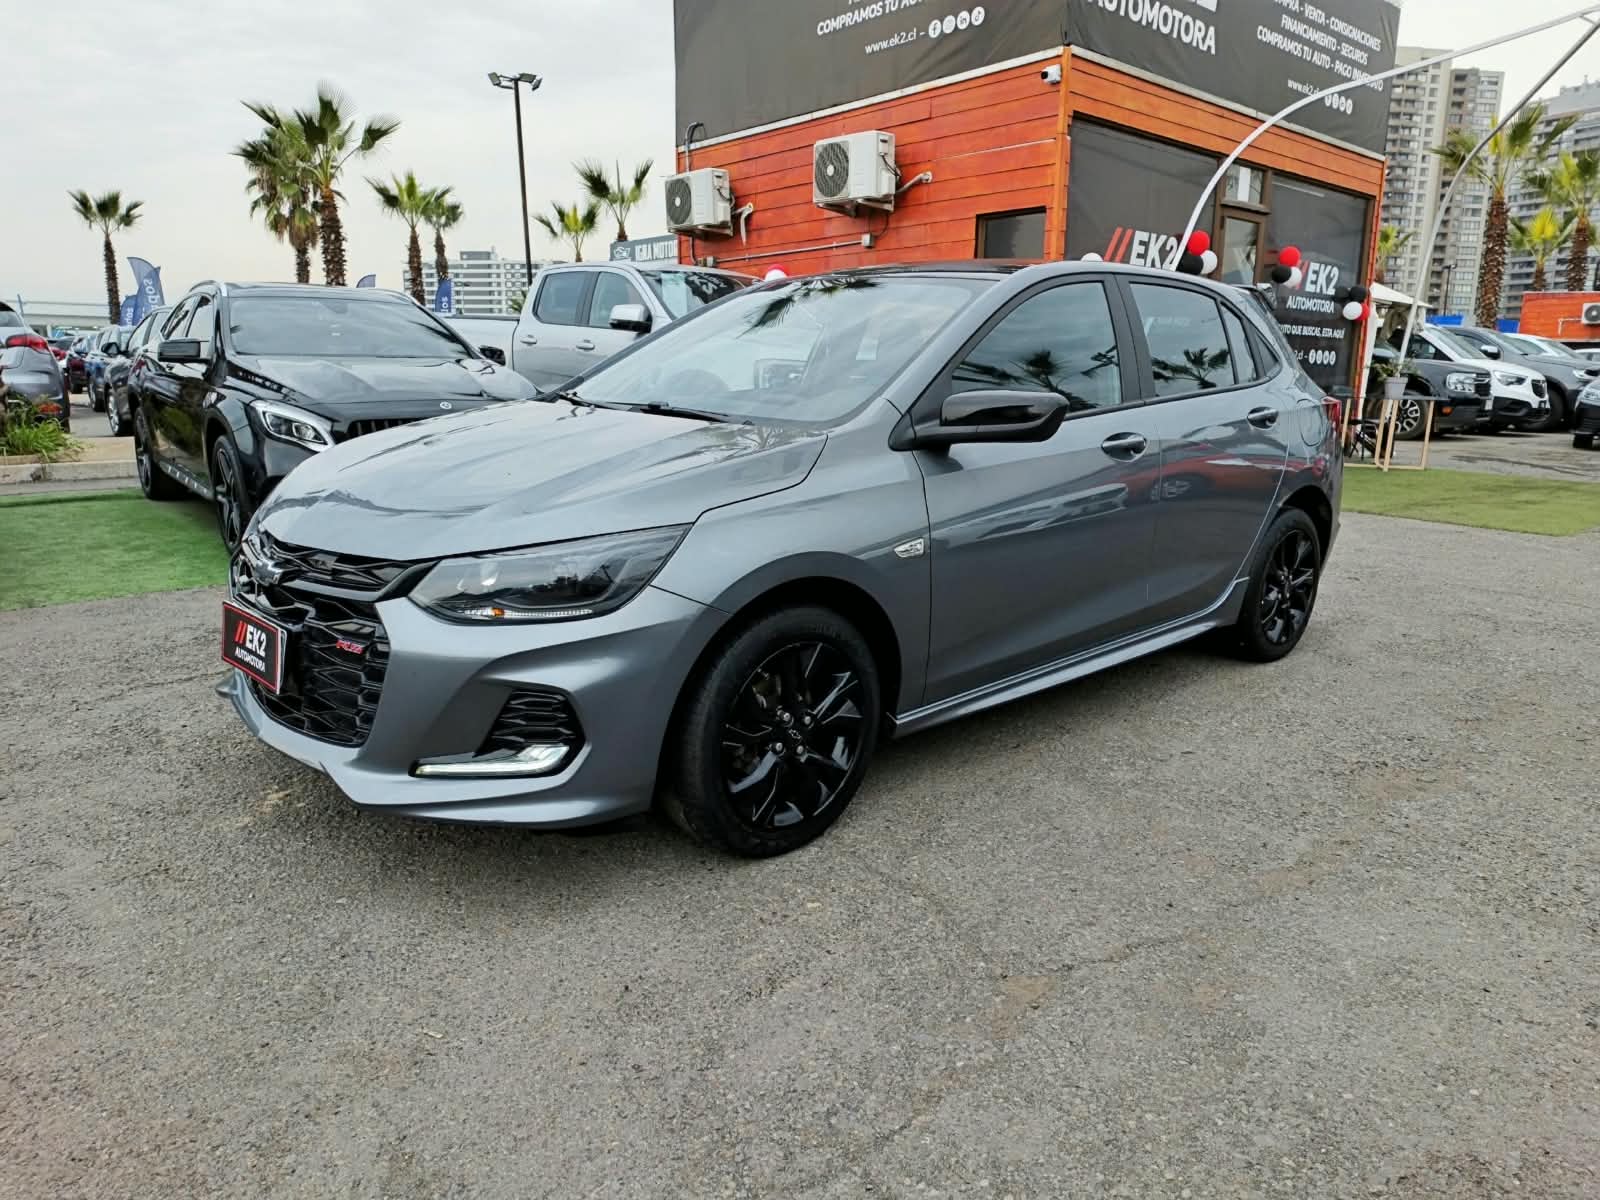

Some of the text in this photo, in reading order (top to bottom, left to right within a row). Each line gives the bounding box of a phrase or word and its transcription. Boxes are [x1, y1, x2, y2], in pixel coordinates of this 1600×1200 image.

[817, 2, 883, 36] COMPRAMOS
[1088, 0, 1216, 56] TOMOTORA
[1304, 3, 1326, 26] VENTA
[1330, 15, 1381, 52] CONSIGNACIONES
[864, 26, 917, 54] www.ek2.cl
[1257, 25, 1303, 57] COMPRAMOS
[1303, 45, 1313, 62] TU
[1312, 50, 1331, 69] AUTO
[1334, 60, 1353, 78] PAGO
[1281, 13, 1337, 51] FINANCIAMIENTO
[1341, 41, 1369, 65] SEGUROS
[1305, 261, 1340, 296] EK2
[1286, 295, 1335, 314] AUTOMOTORA
[1291, 324, 1303, 336] QUE
[245, 623, 267, 658] EK2
[234, 645, 266, 673] AUTOMOTORA
